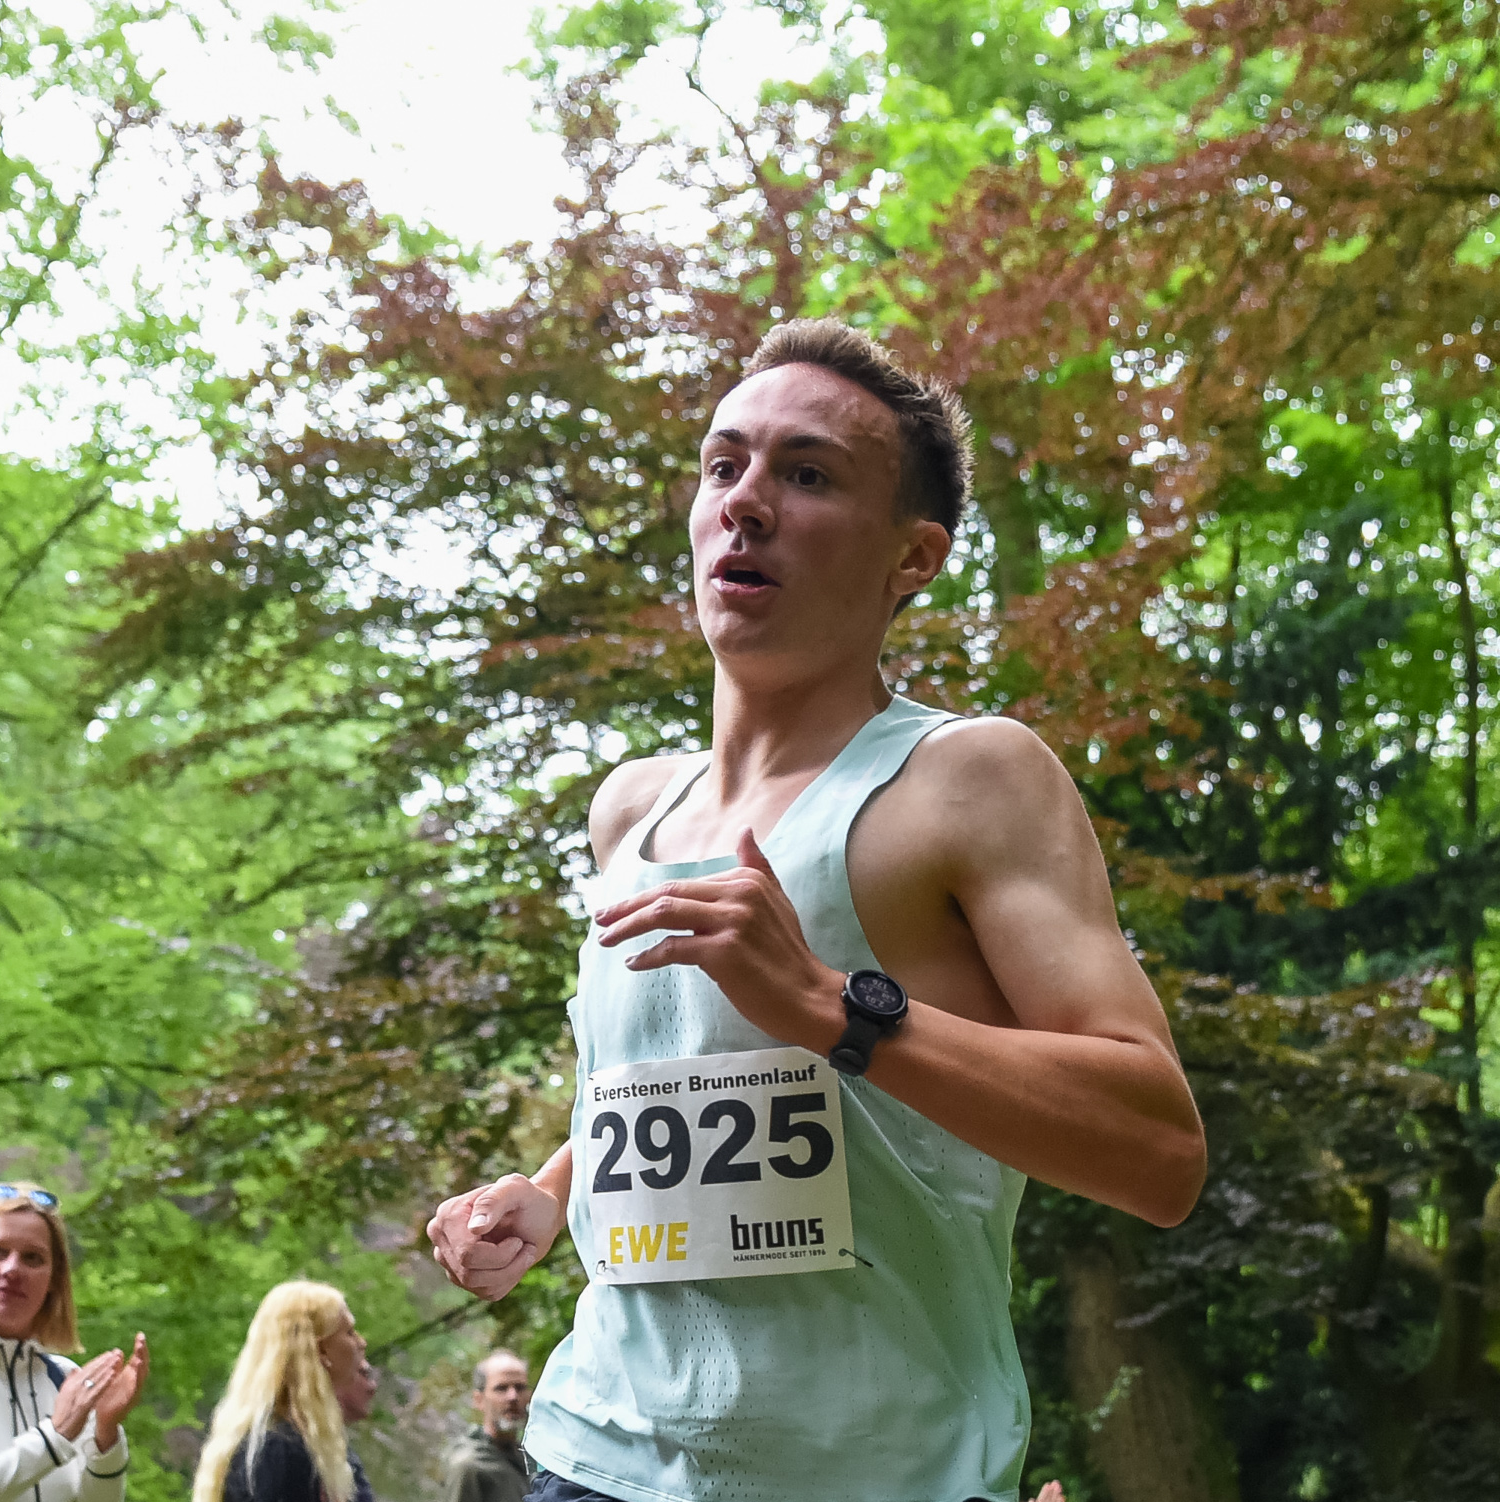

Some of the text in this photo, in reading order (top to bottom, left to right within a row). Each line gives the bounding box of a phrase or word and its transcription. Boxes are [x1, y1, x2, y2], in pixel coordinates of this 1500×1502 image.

[594, 1064, 817, 1102] Everstener Brunnenlauf
[590, 1091, 835, 1194] 2925
[609, 1221, 689, 1265] EWE
[730, 1214, 825, 1251] bruns
[790, 1250, 806, 1258] SEIT
